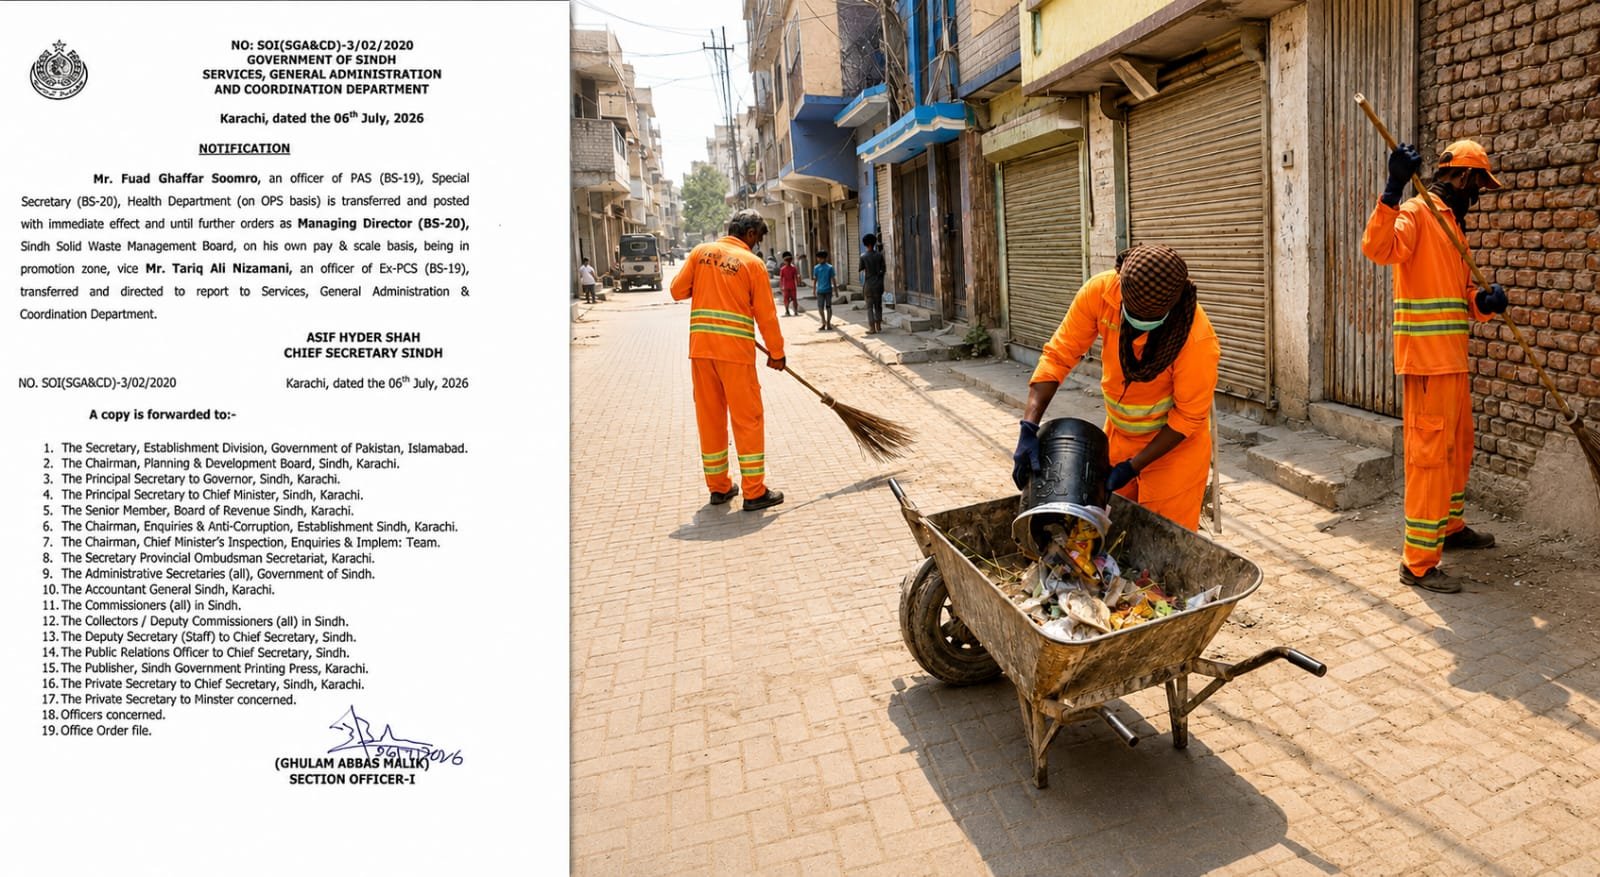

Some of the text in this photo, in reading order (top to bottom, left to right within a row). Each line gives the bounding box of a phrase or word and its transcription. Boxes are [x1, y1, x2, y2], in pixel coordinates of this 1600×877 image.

[232, 40, 413, 51] NO: SOI(SGA&CD)-3/02/2020
[247, 55, 396, 65] GOVERNMENT OF SINDH
[203, 69, 441, 81] SERVICES, GENERAL ADMINISTRATION
[214, 84, 429, 94] AND COORDINATION DEPARTMENT
[220, 113, 268, 125] Karachi,
[272, 113, 306, 123] dated
[310, 113, 330, 123] the
[361, 112, 389, 126] July,
[394, 113, 424, 123] 2026
[199, 143, 290, 155] NOTIFICATION
[94, 173, 469, 185] Mr. Fuad Ghaffar Soomro, an officer of PAS (BS-19), Special
[22, 195, 469, 209] Secretary (BS-20), Health Department (on OPS basis) is transferred and posted
[21, 218, 469, 231] with immediate effect and until further orders as Managing Director (BS-20),
[21, 240, 469, 253] Sindh Solid Waste Management Board, on his own pay & scale basis, being in
[20, 309, 157, 321] Coordination Department.
[307, 332, 420, 343] ASIF HYDER SHAH
[284, 348, 443, 358] CHIEF SECRETARY SINDH
[19, 377, 176, 390] NO. SOI(SGA&CD)-3/02/2020
[286, 378, 329, 390] Karachi,
[333, 377, 364, 388] dated
[368, 378, 385, 388] the
[413, 378, 438, 391] July,
[442, 378, 469, 388] 2026
[89, 409, 236, 422] A copy is forwarded to:-
[45, 442, 468, 455] 1. The Secretary, Establishment Division, Government of Pakistan, Islamabad.
[44, 473, 340, 486] 3. The Principal Secretary to Governor, Sindh, Karachi.
[43, 521, 458, 534] 6. The Chairman, Enquiries & Anti-Corruption, Establishment Sindh, Karachi.
[43, 552, 374, 565] 8. The Secretary Provincial Ombudsman Secretariat, Karachi.
[43, 631, 356, 644] 13. The Deputy Secretary (Staff) to Chief Secretary, Sindh.
[43, 662, 368, 676] 15. The Publisher, Sindh Government Printing Press, Karachi.
[43, 709, 165, 720] 18. Officers concerned.
[43, 725, 151, 736] 19. Office Order file.
[275, 757, 430, 771] (GHULAM ABBAS MALIK)
[289, 774, 415, 784] SECTION OFFICER-I
